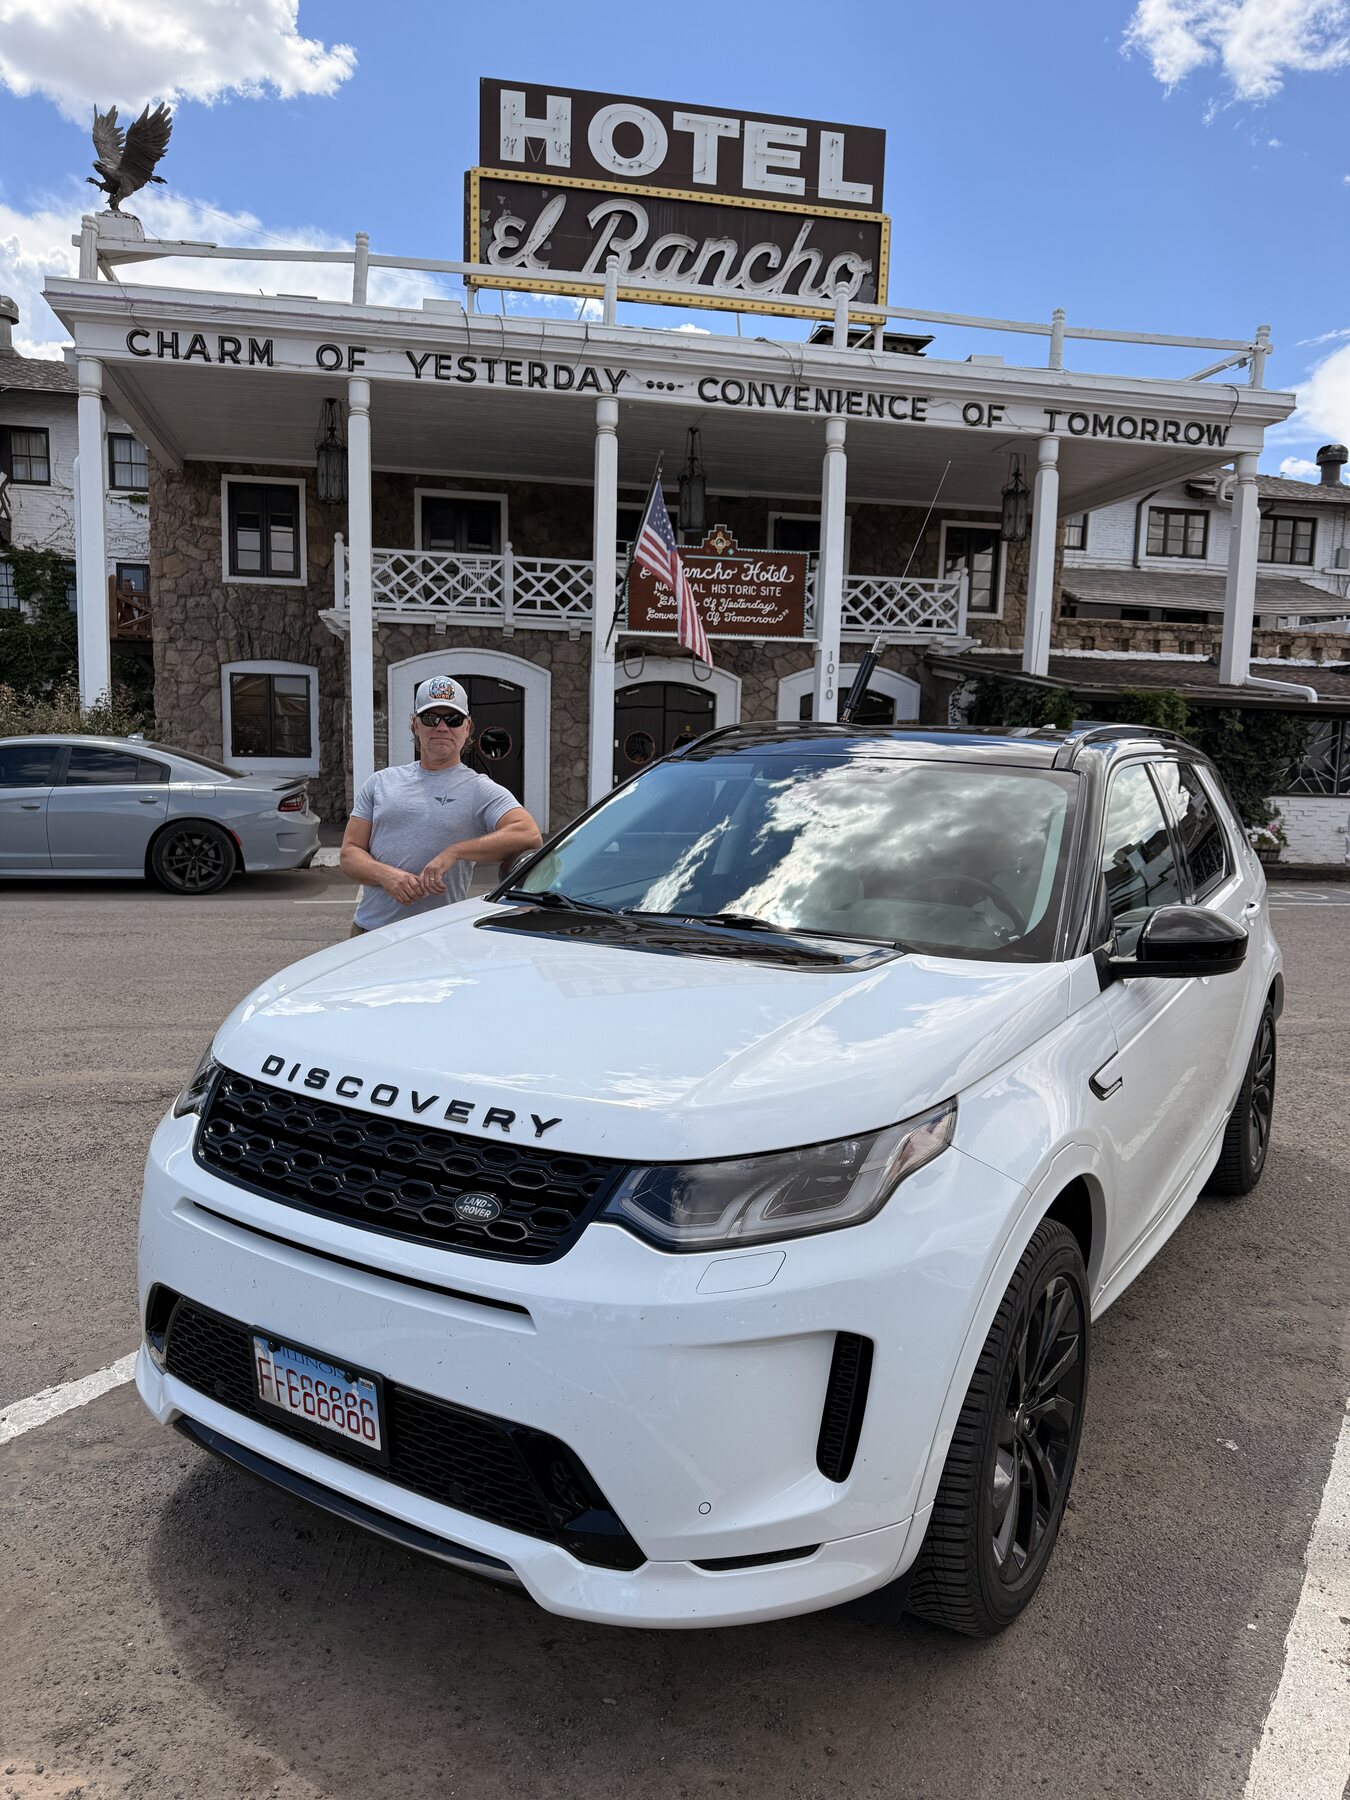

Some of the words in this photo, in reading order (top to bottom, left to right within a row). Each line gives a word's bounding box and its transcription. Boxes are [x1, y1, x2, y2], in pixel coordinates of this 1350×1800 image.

[500, 89, 873, 204] HOTEL
[582, 199, 873, 301] Rancho
[126, 328, 274, 367] CHARM
[316, 343, 367, 372] OF
[406, 350, 629, 394] YESTERDAY
[697, 376, 928, 423] CONVENIENCE
[962, 401, 1006, 428] OF
[1044, 408, 1231, 447] TOMORROW
[680, 560, 738, 580] ancho
[741, 562, 795, 584] Hotel
[711, 584, 757, 596] HISTORIC
[760, 586, 782, 597] SITE
[703, 597, 717, 612] Of
[706, 611, 721, 626] Of
[261, 1054, 563, 1138] DISCOVERY
[462, 1205, 492, 1219] ROVER
[463, 1195, 488, 1209] LAND
[281, 1347, 346, 1380] ILLINOIS
